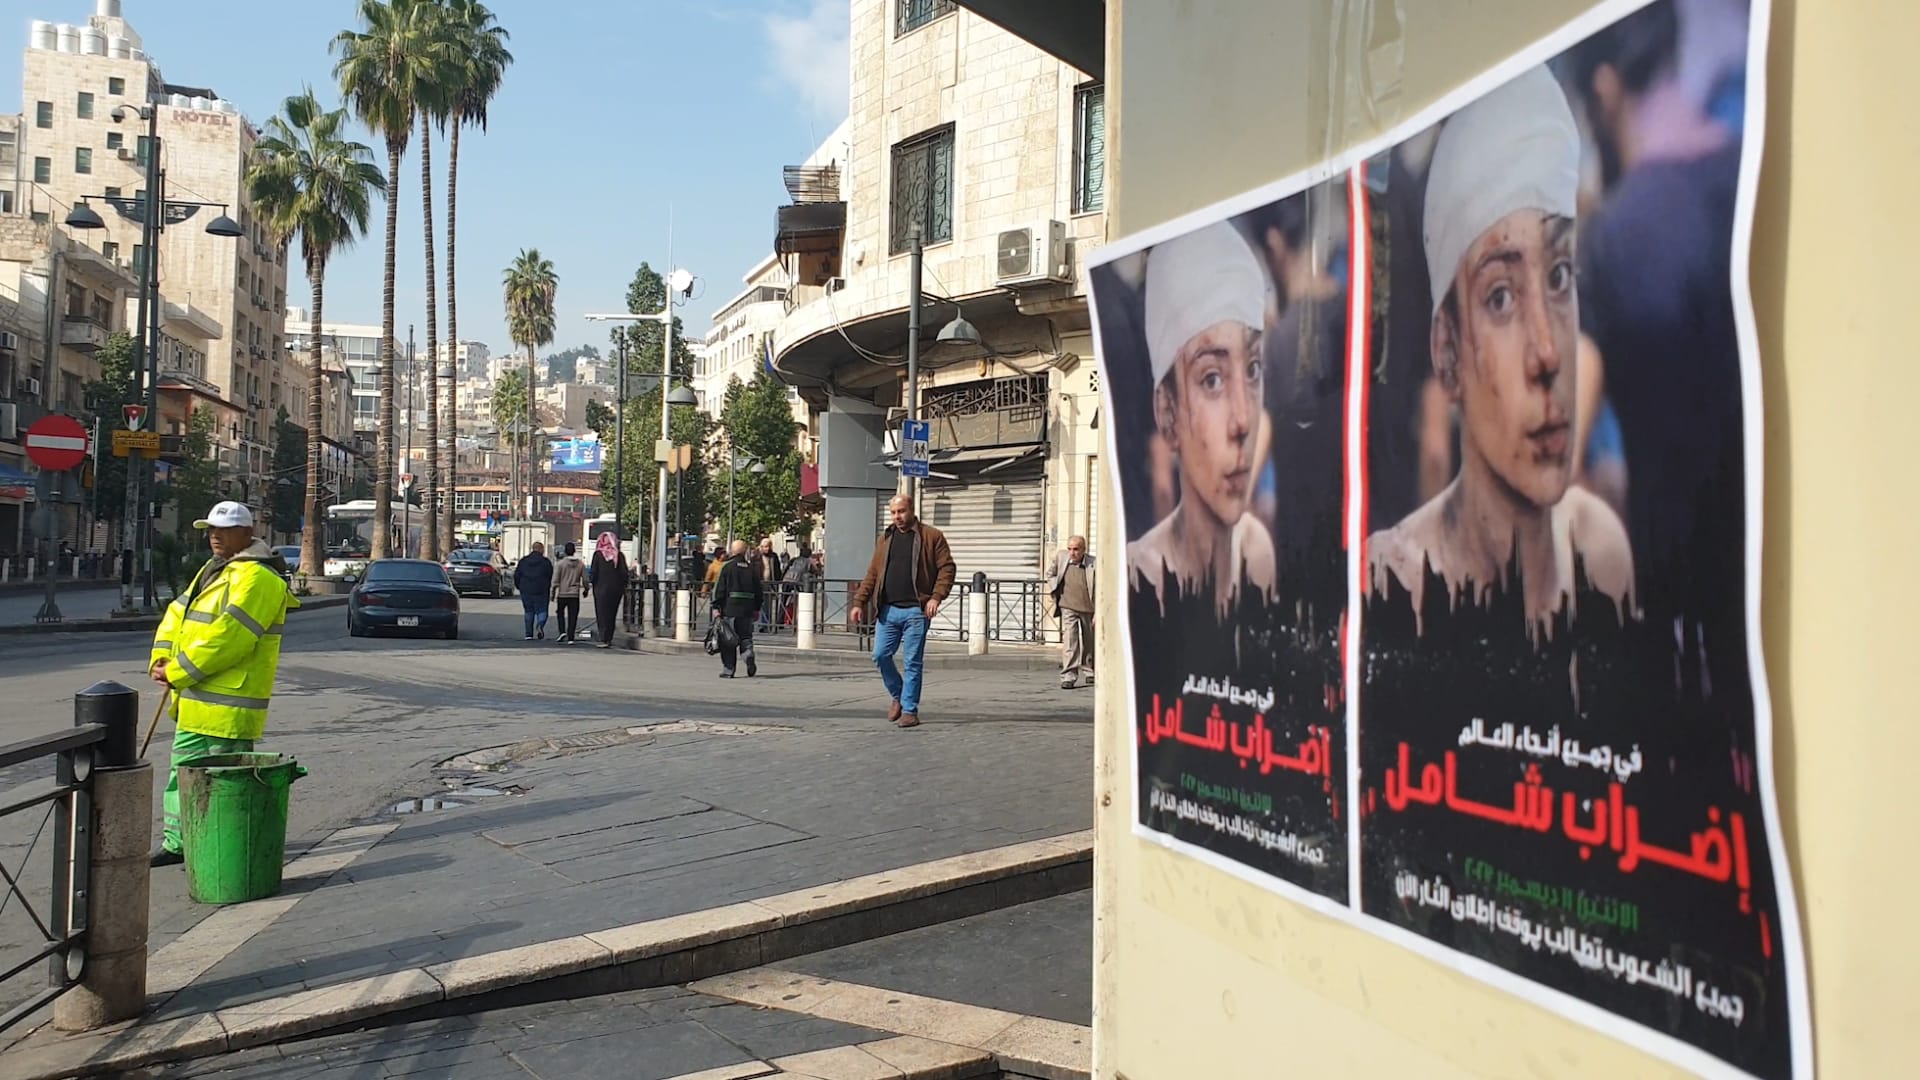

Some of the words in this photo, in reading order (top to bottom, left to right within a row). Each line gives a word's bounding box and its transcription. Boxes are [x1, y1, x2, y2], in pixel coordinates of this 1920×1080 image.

[173, 110, 233, 127] HOTEL
[1182, 673, 1208, 695] العالم
[1229, 685, 1257, 708] جميع
[1257, 686, 1275, 714] في
[1145, 693, 1226, 752] شامل
[1458, 716, 1515, 749] العالم
[1515, 724, 1560, 758] أنحاء
[1229, 714, 1332, 793] إضراب
[1562, 738, 1613, 774] جميع
[1613, 744, 1643, 783] في
[1385, 741, 1554, 833] شامل
[1256, 829, 1297, 856] الشعوب
[1297, 841, 1324, 864] جميع
[1562, 782, 1752, 915] إضراب
[1419, 875, 1451, 911] النار
[1496, 870, 1559, 908] ديسمبر
[1450, 894, 1496, 933] إطلاق
[1497, 905, 1542, 950] بوقف
[1544, 926, 1604, 971] تطالب
[1605, 948, 1692, 999] الشعوب
[1695, 980, 1745, 1028] جميع
